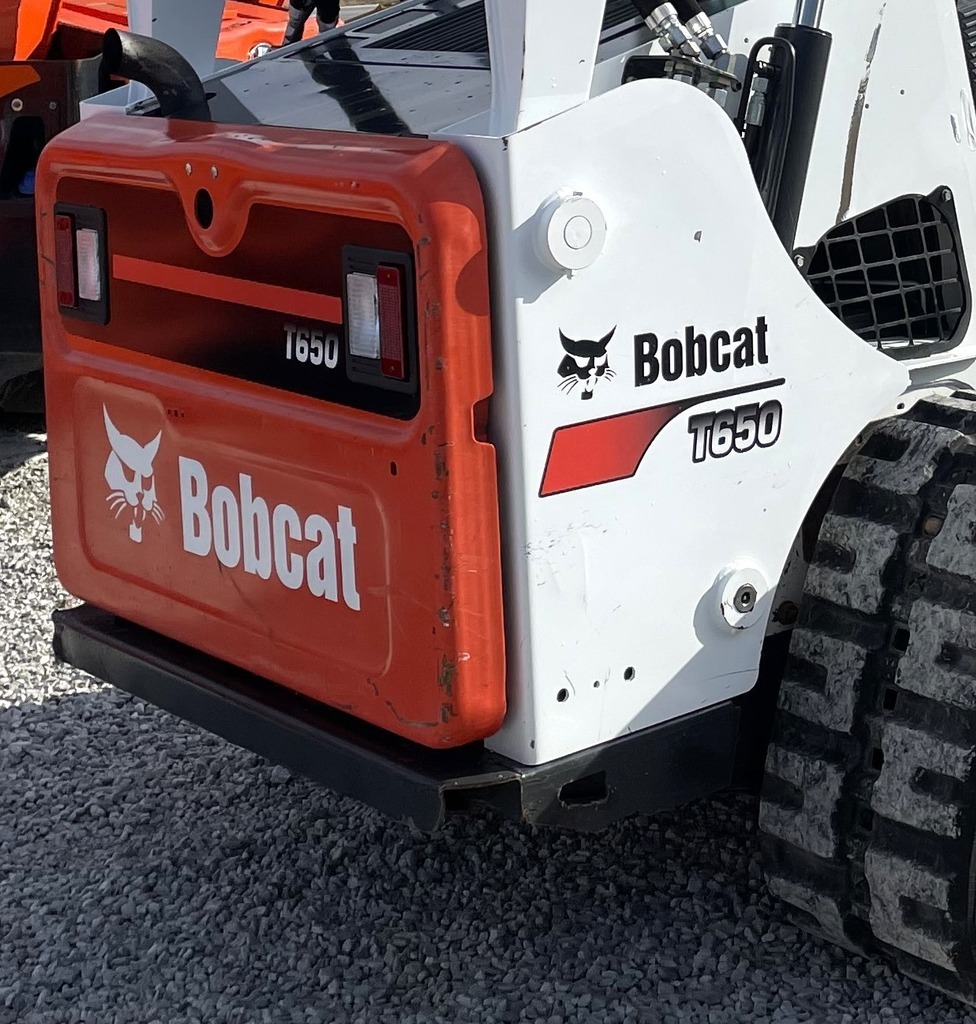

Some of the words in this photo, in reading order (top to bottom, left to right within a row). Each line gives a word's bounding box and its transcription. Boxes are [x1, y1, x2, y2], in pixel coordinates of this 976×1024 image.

[283, 324, 339, 369] T650
[634, 316, 769, 387] Bobcat
[688, 399, 783, 463] T650
[178, 455, 361, 611] Bobcat
